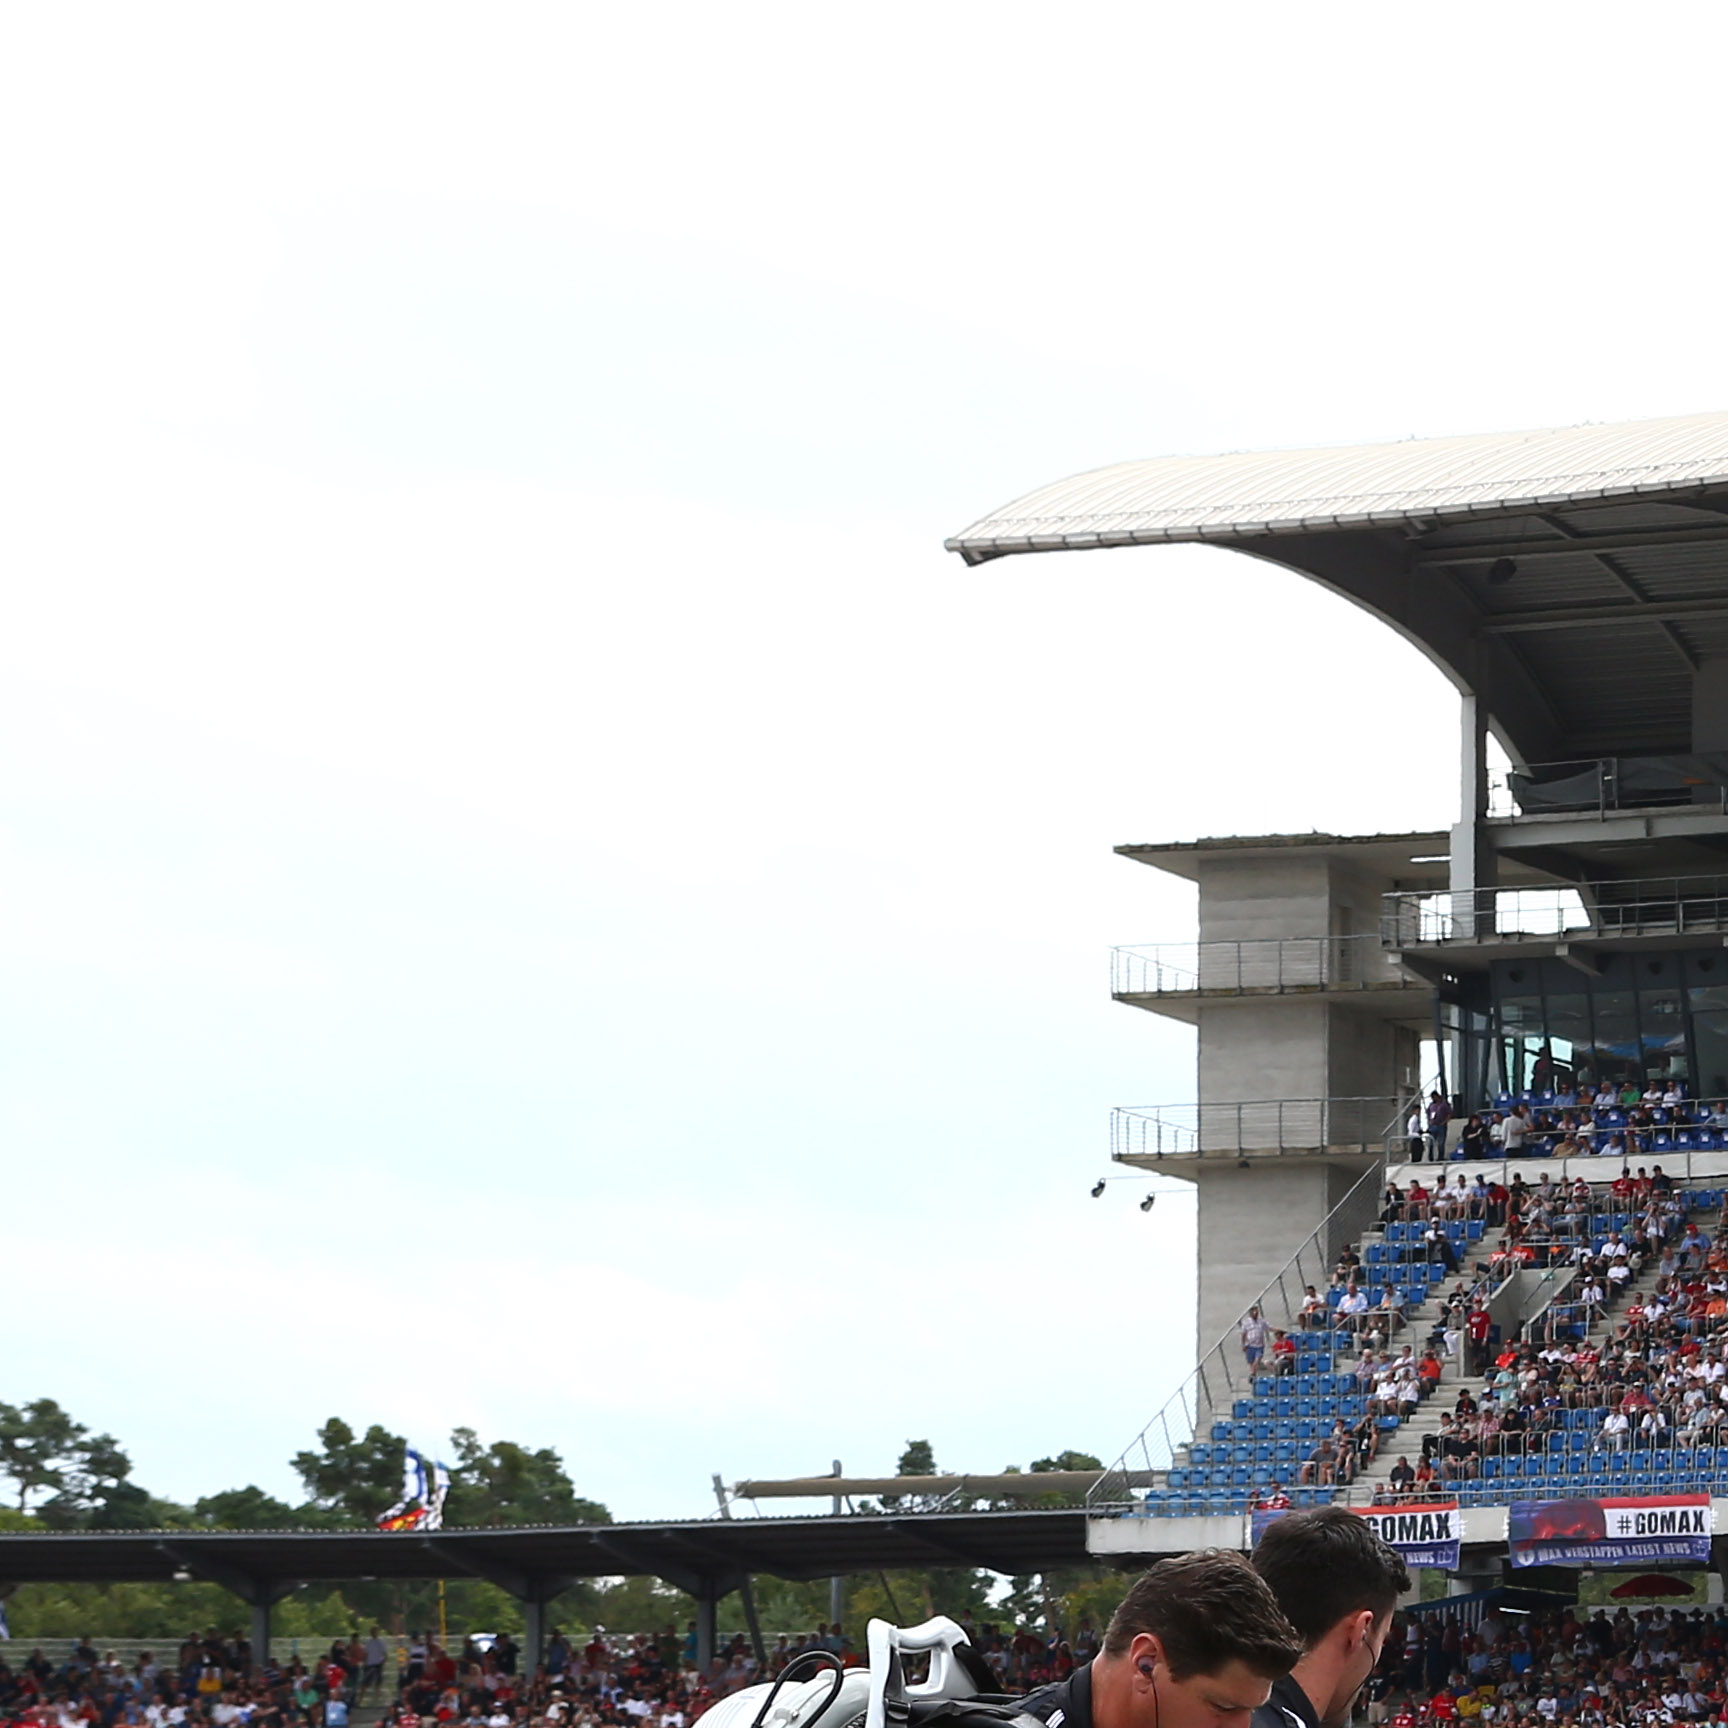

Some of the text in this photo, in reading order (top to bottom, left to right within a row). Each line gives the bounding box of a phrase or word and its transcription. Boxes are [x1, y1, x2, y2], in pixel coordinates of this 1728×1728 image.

[1366, 1513, 1451, 1543] GOMAX
[1616, 1510, 1705, 1535] #GOMAX
[1406, 1550, 1435, 1565] NEWS
[1539, 1541, 1691, 1563] MAX VERSTAPPEN LATEST NEWS
